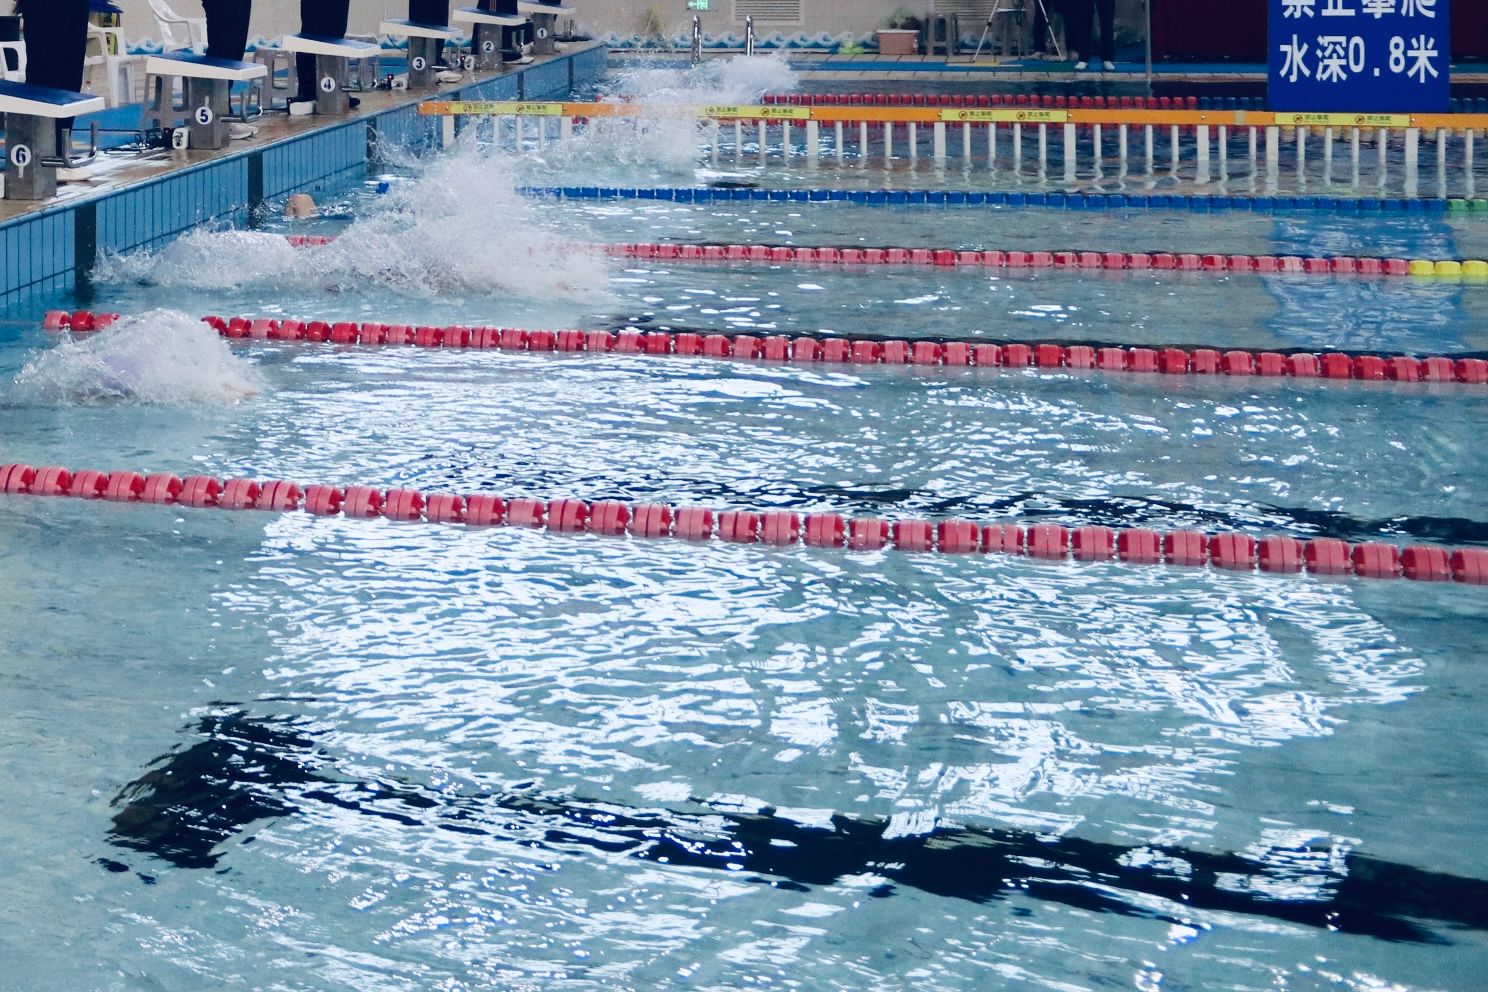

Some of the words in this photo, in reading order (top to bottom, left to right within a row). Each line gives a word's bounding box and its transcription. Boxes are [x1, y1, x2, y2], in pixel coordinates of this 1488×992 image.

[539, 28, 545, 37] 1
[485, 42, 492, 51] 2
[415, 59, 423, 68] 3
[1279, 33, 1439, 84] 水深0.8米
[323, 79, 332, 90] 4
[199, 109, 209, 123] 5
[15, 147, 27, 163] 6
